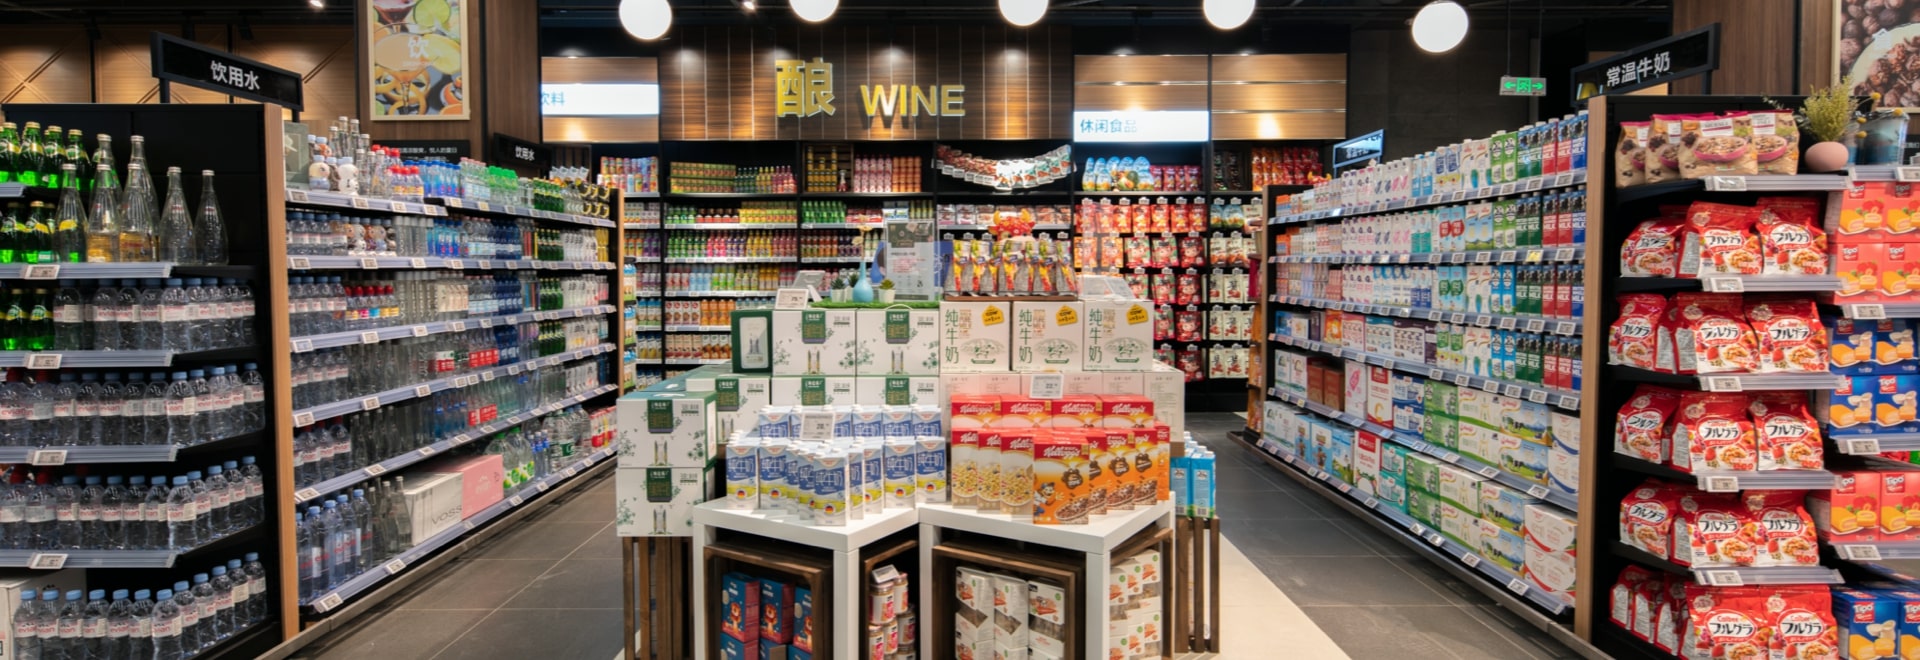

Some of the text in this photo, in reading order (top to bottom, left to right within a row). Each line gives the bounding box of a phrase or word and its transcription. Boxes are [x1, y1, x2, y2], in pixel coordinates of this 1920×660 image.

[408, 36, 429, 58] 饮
[211, 60, 260, 90] 饮用水
[1606, 51, 1671, 88] 常温牛奶
[775, 57, 836, 118] 酿
[860, 85, 965, 117] WINE
[1080, 118, 1137, 133] 休闲食品
[515, 145, 535, 161] 饮用水
[1771, 232, 1810, 244] フルグラ
[944, 308, 960, 365] 纯牛奶
[1019, 308, 1033, 364] 纯牛奶
[1089, 307, 1103, 364] 纯牛奶
[1700, 327, 1739, 339] フルグラ
[1769, 328, 1809, 340] フルグラ
[1010, 402, 1044, 415] Kellogg's
[1061, 402, 1095, 415] Kellogg's
[1111, 403, 1146, 416] Kellogg's
[1704, 427, 1739, 438] フルグラ
[1766, 425, 1805, 436] フルグラ
[1043, 445, 1080, 461] Kellogg's
[1886, 476, 1904, 485] Tipo
[432, 505, 462, 524] VOSS
[1699, 520, 1738, 532] フルグラ
[1762, 519, 1801, 531] フルグラ
[1853, 604, 1873, 613] Tipo
[1904, 604, 1920, 613] Tip
[1709, 622, 1754, 635] フルグラ
[1782, 622, 1823, 635] フルグラ
